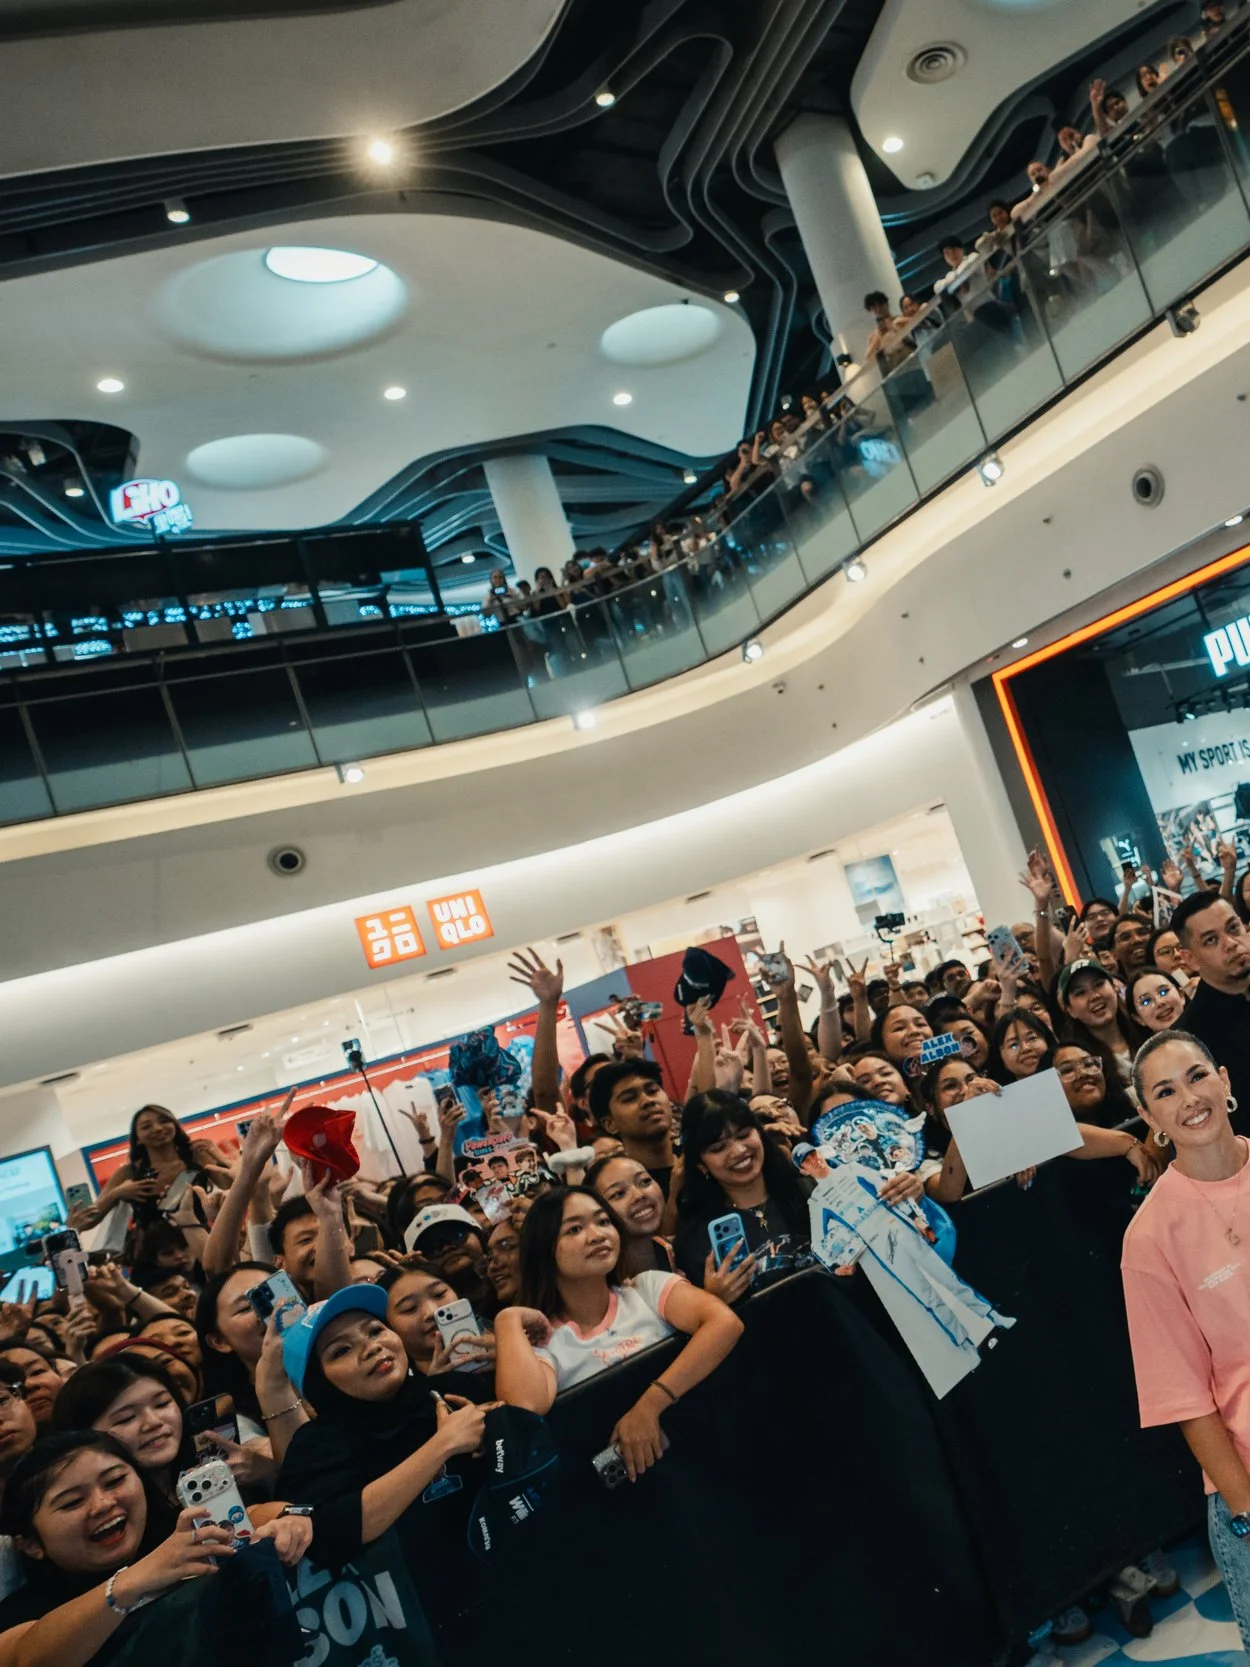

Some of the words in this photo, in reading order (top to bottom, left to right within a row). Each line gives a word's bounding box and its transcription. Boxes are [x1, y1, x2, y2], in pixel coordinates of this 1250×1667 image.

[1176, 750, 1198, 775] MY
[1198, 742, 1238, 769] SPORT
[920, 1042, 960, 1063] ALBON
[495, 1439, 505, 1474] betway
